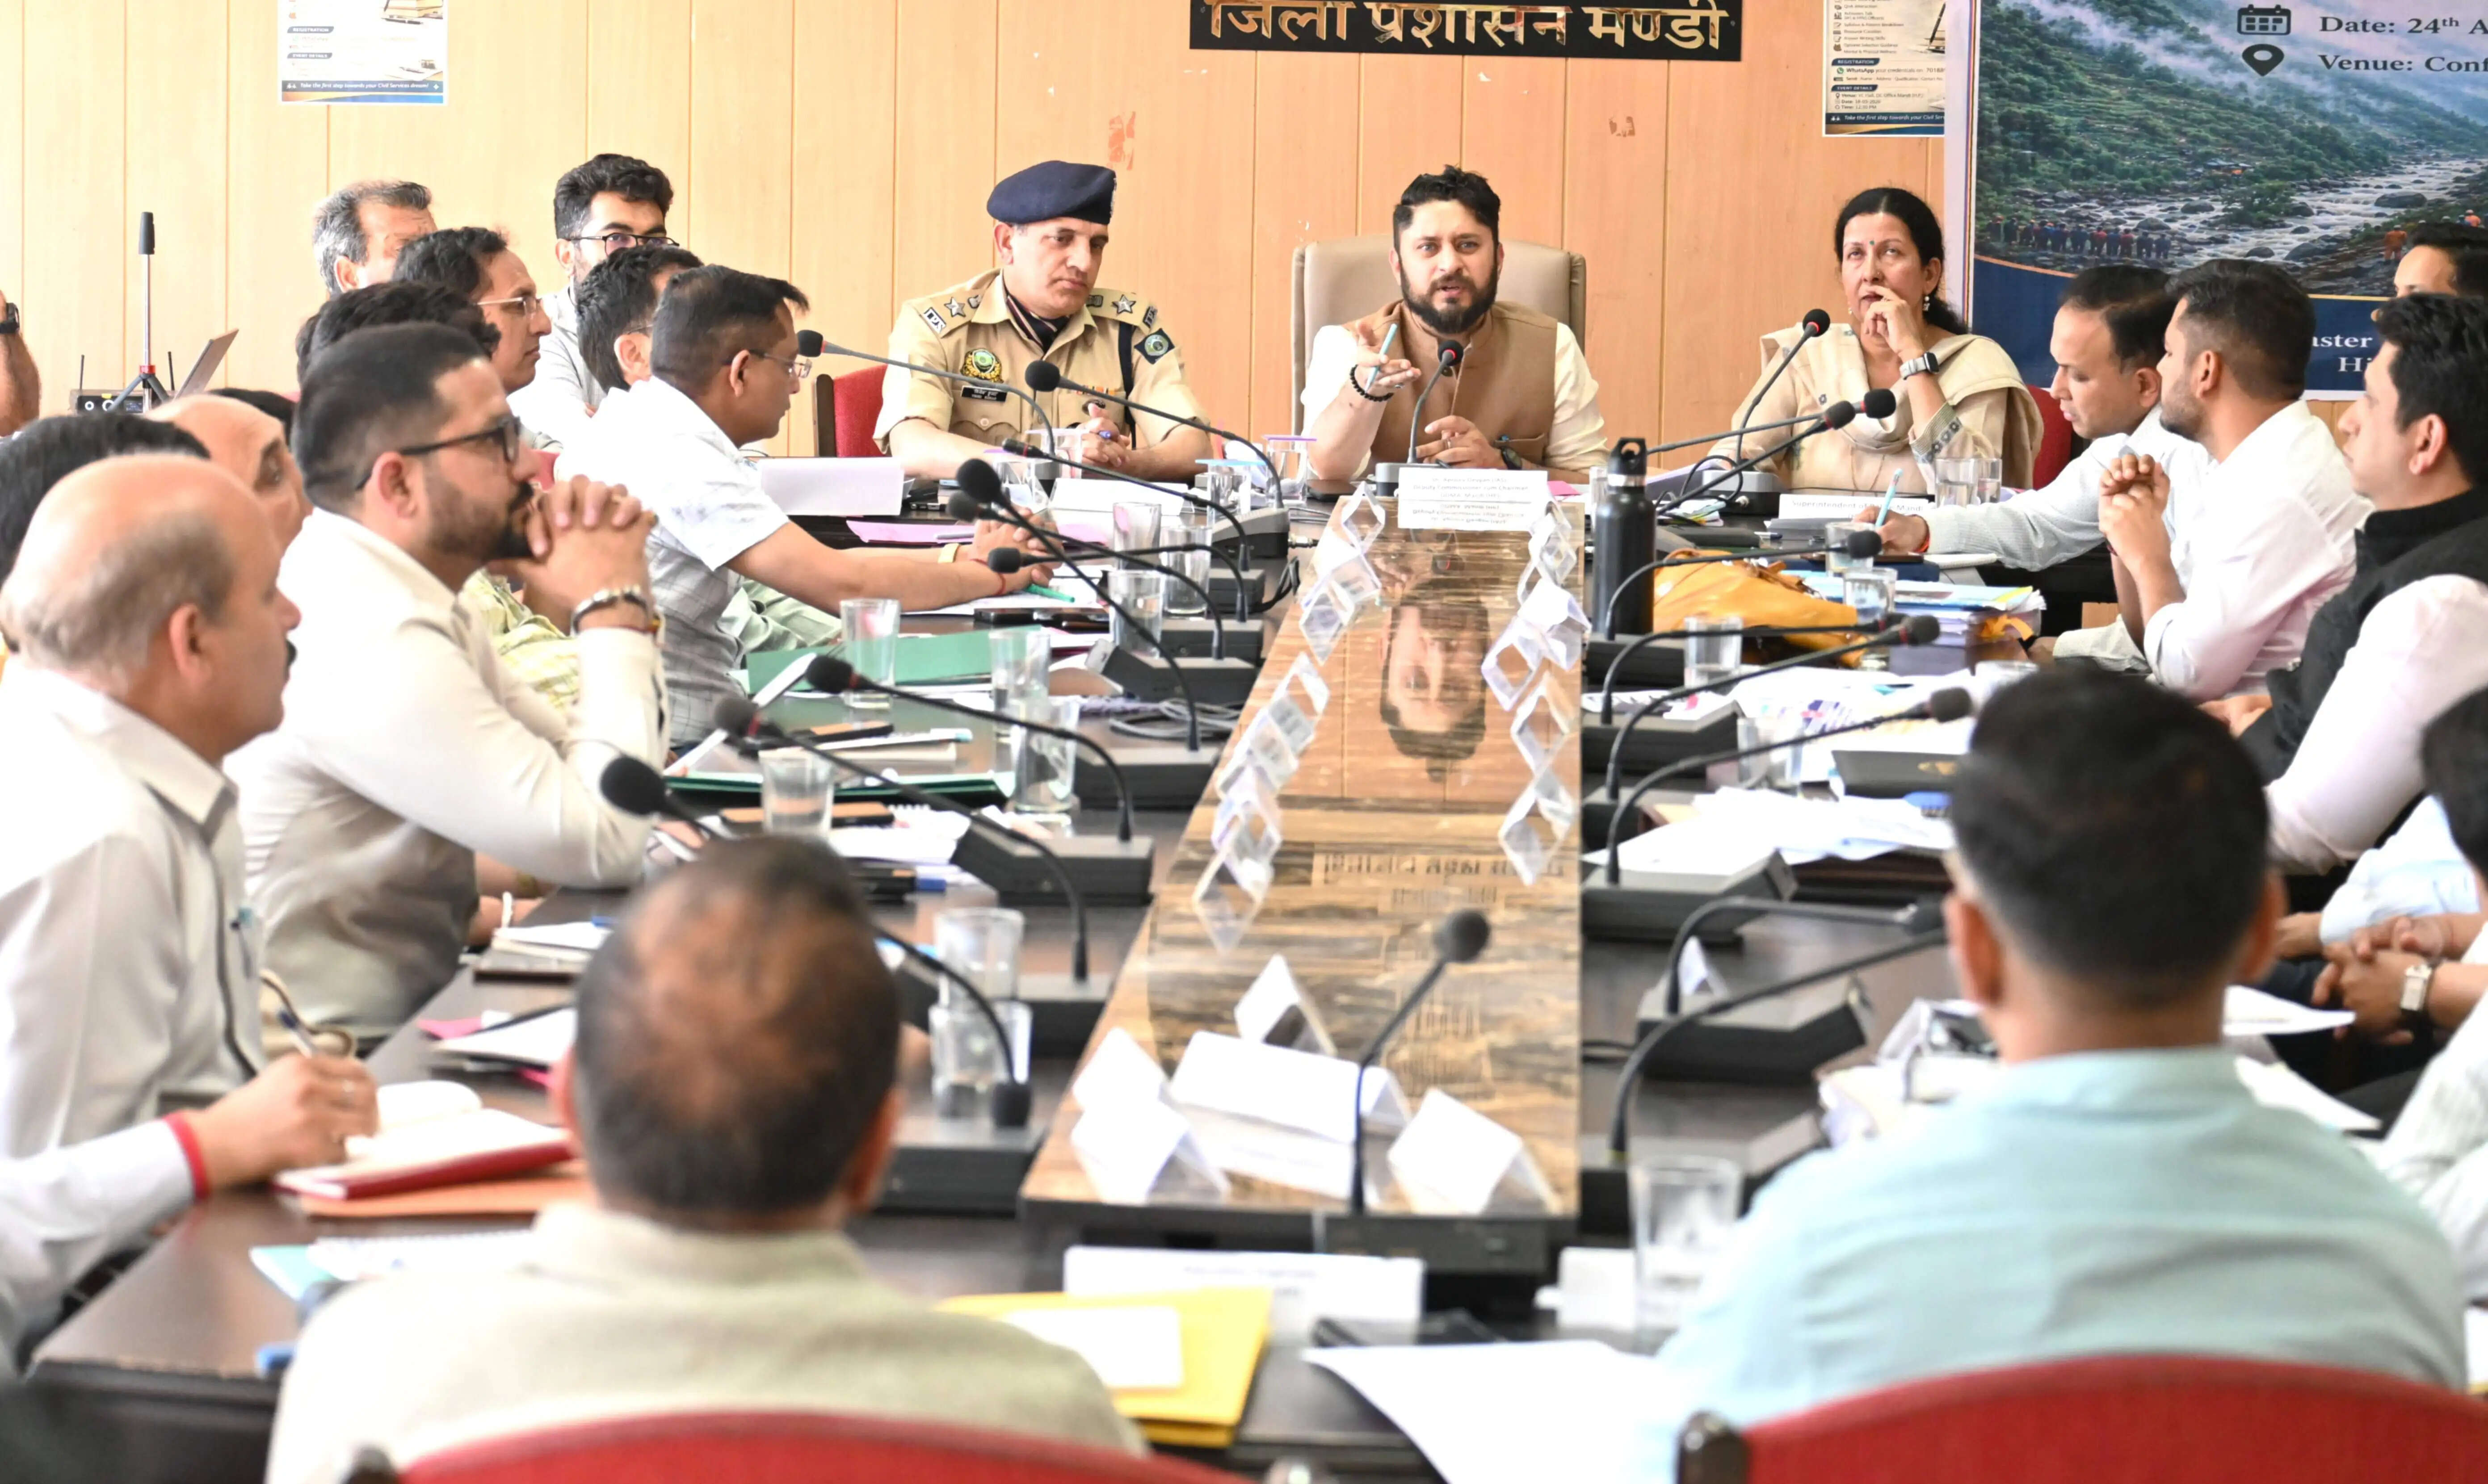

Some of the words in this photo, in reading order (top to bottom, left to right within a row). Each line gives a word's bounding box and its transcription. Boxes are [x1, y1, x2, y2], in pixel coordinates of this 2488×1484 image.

[1204, 0, 1356, 41] जिला
[1363, 2, 1573, 48] प्रशासन
[1581, 0, 1729, 49] मण्डी
[2319, 16, 2395, 33] Date:
[2408, 17, 2459, 34] 24th
[2318, 54, 2413, 71] Venue:
[1792, 500, 1856, 509] Superintendent
